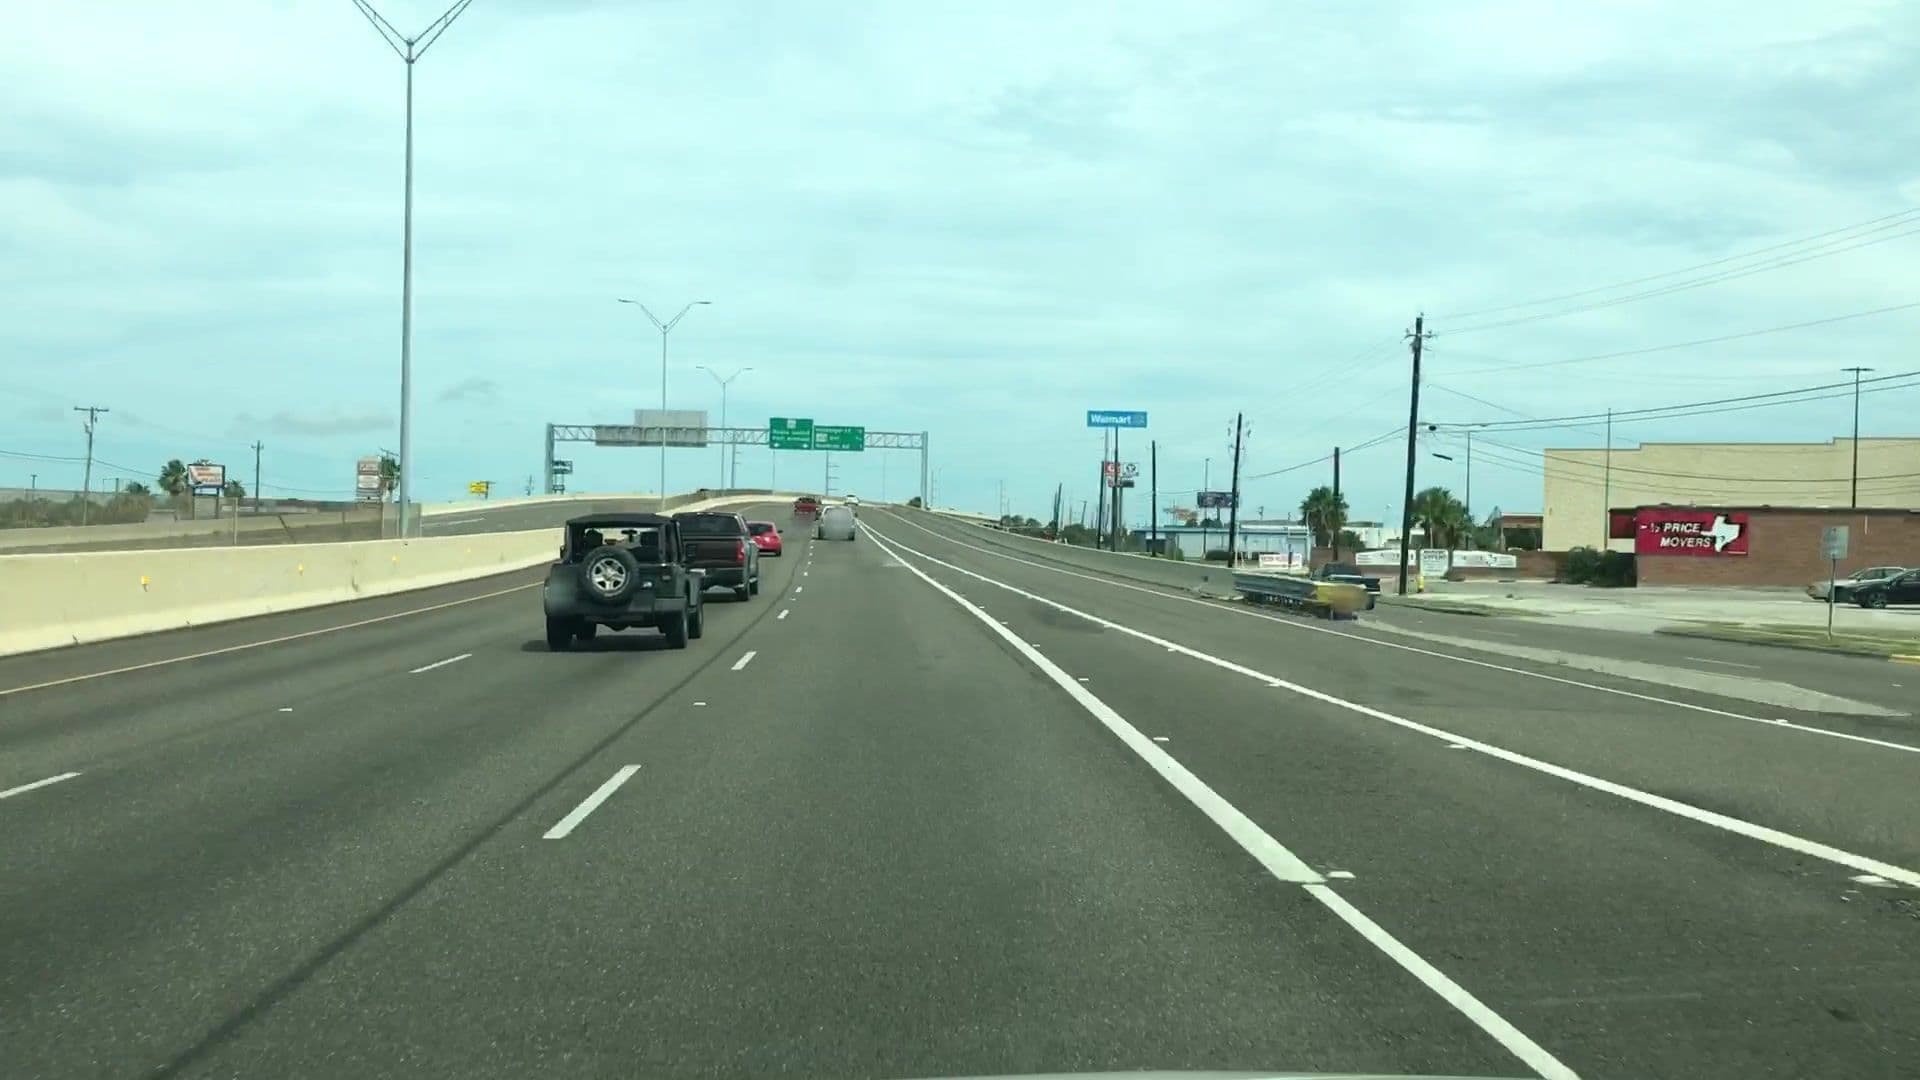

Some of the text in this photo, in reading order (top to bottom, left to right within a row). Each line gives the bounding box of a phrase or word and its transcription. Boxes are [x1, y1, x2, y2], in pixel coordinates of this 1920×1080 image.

[1090, 413, 1132, 424] Walmart
[1663, 522, 1701, 533] PRICE
[1660, 536, 1711, 548] MOVERS
